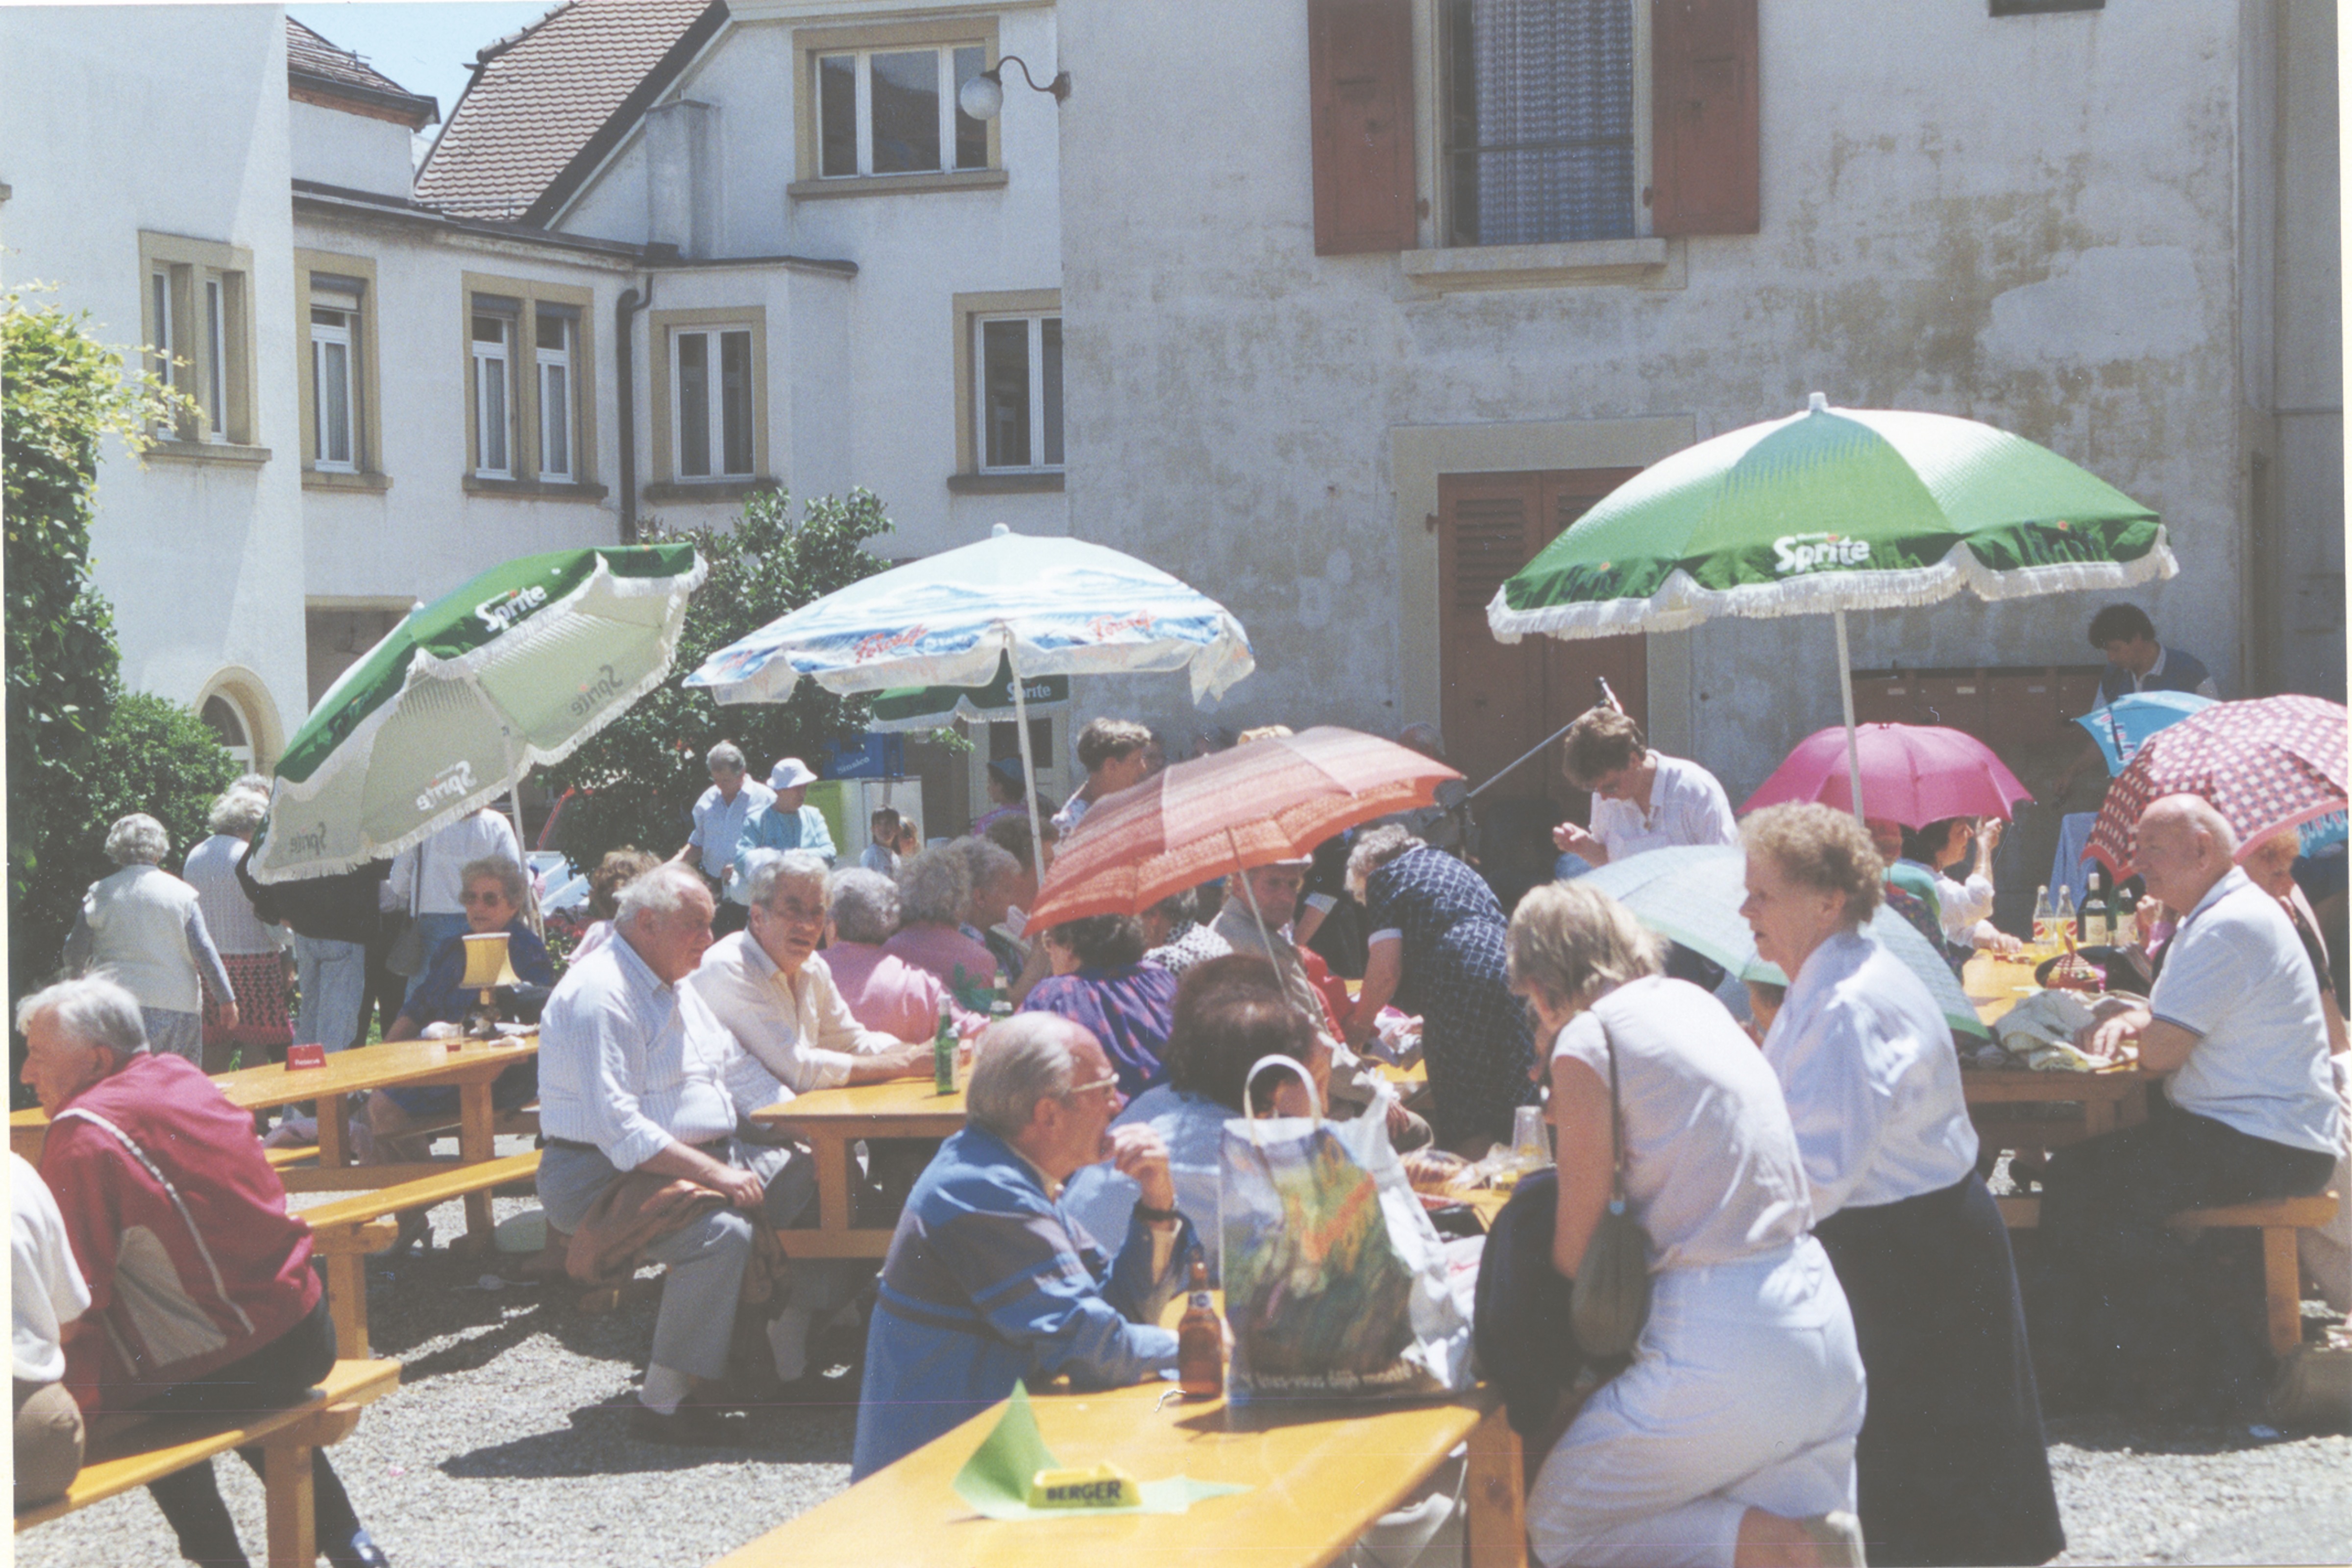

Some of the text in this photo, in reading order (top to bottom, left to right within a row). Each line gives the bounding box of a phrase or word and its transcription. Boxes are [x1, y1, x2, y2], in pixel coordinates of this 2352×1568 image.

[1770, 535, 1870, 574] Sprite
[475, 586, 547, 633] Sprite
[1047, 1480, 1121, 1501] BERGER
